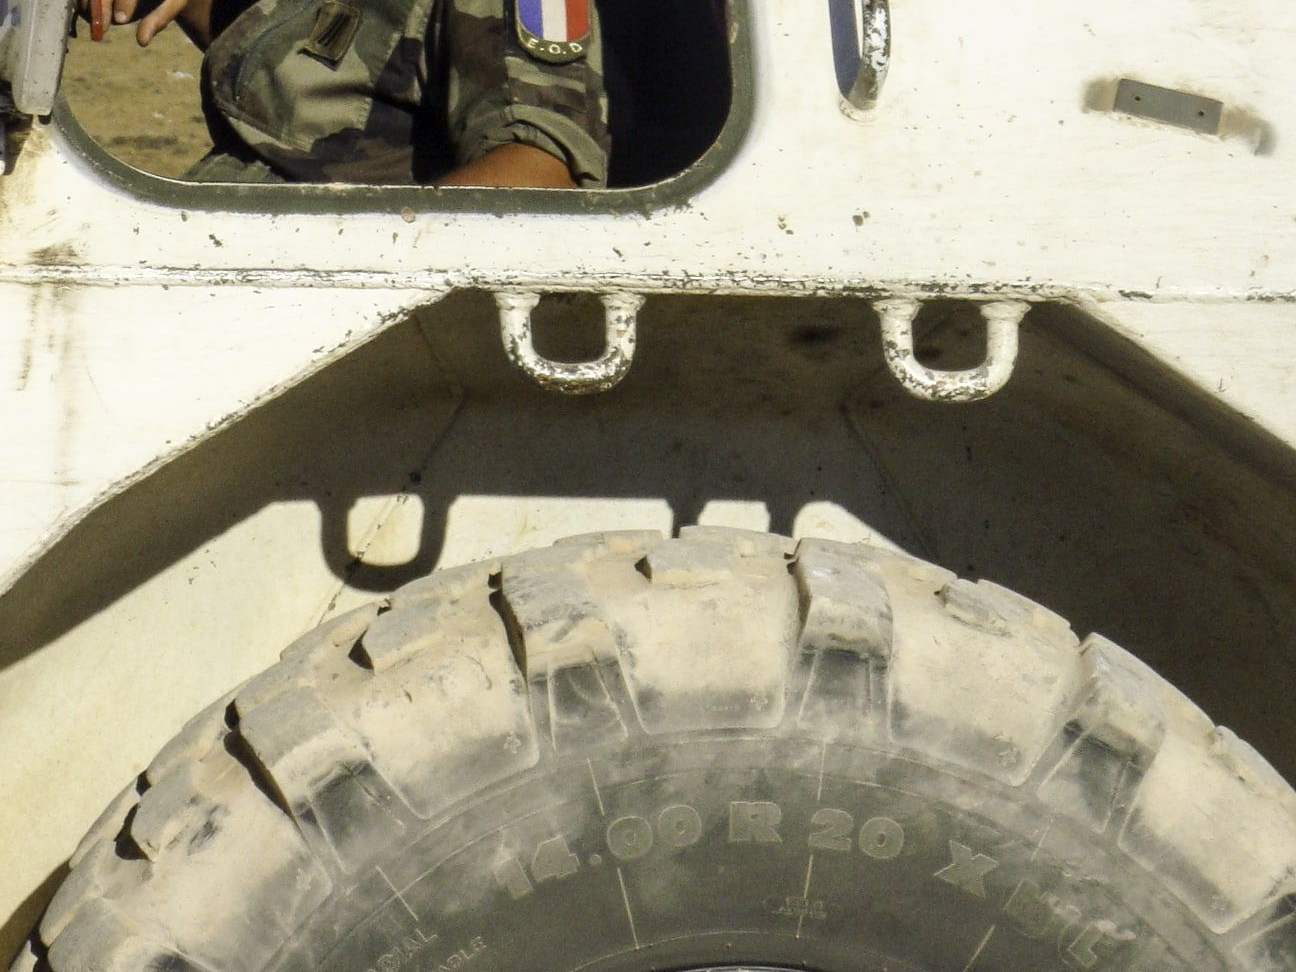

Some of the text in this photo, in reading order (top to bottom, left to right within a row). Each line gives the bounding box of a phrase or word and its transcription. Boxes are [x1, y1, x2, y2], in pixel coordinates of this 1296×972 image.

[494, 803, 703, 901] 14.00
[728, 800, 784, 844] R
[807, 807, 905, 860] 20
